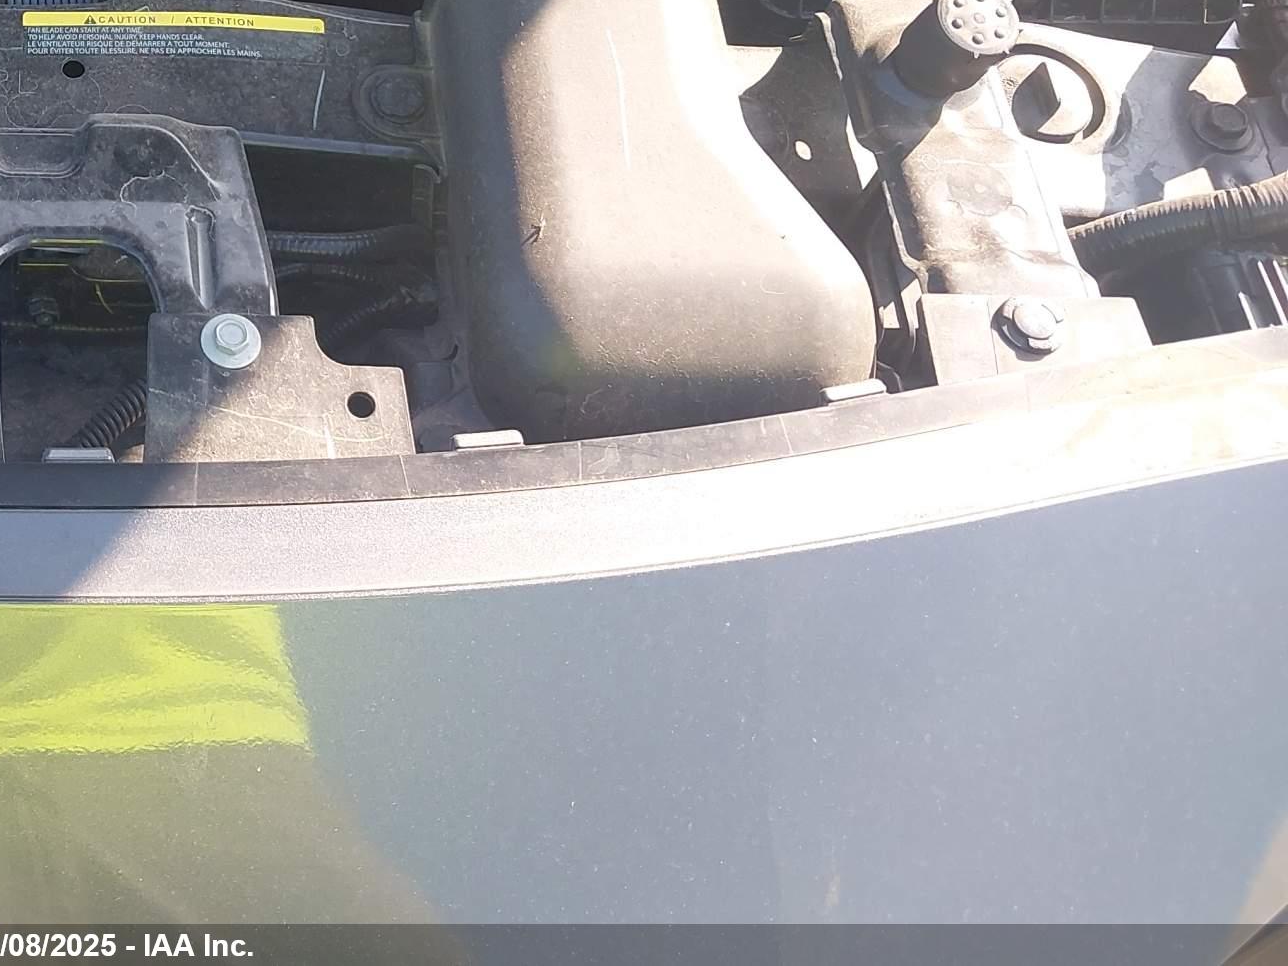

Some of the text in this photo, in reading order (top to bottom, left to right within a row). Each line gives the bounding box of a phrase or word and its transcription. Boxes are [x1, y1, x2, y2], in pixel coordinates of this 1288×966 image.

[98, 15, 156, 24] CAUTION
[185, 16, 255, 27] ATTENTION
[28, 26, 41, 34] FAN
[42, 26, 64, 34] BLADE
[64, 26, 79, 34] CAN
[80, 26, 100, 34] START
[102, 26, 111, 34] AT
[111, 26, 125, 34] ANY
[27, 40, 36, 48] LE
[37, 40, 85, 48] VENTILATEUR
[86, 40, 113, 48] RISQUE
[114, 40, 125, 48] DE
[173, 40, 194, 48] TOUT
[195, 41, 230, 49] MOMENT.
[27, 47, 49, 55] POUR
[75, 47, 98, 55] TOUTE
[100, 47, 138, 55] BLESSURE,
[139, 47, 150, 55] NE
[150, 47, 165, 55] PAS
[165, 47, 176, 55] EN
[177, 47, 222, 55] APPROCHER
[222, 48, 235, 56] LES
[236, 49, 262, 58] MAINS.
